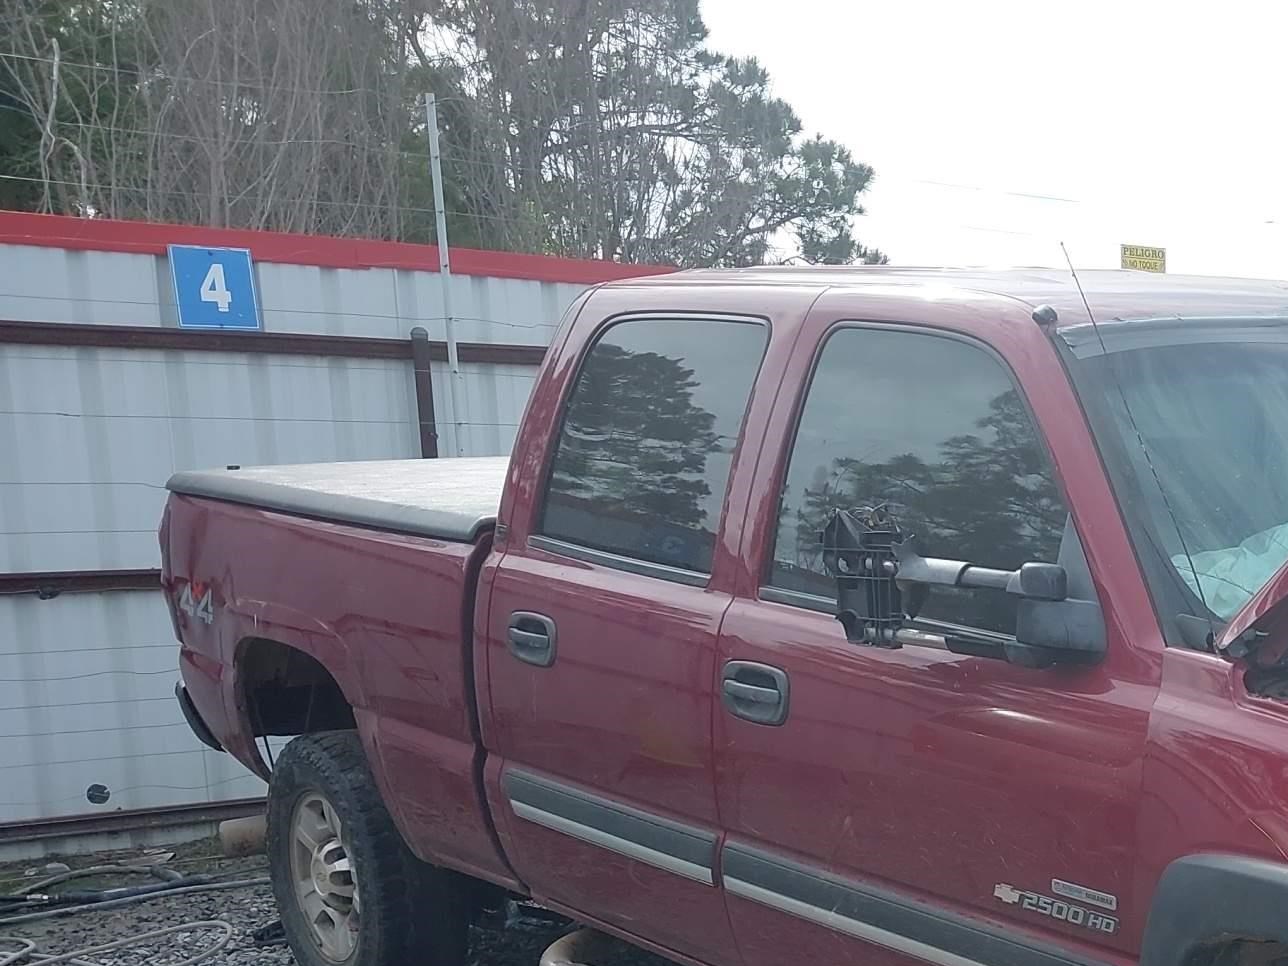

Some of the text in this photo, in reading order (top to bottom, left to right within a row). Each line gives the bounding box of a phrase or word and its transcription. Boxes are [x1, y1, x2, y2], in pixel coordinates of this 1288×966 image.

[1123, 247, 1164, 259] PELIGRO
[200, 263, 232, 312] 4
[1022, 891, 1085, 925] 2500
[1087, 913, 1116, 933] HD
